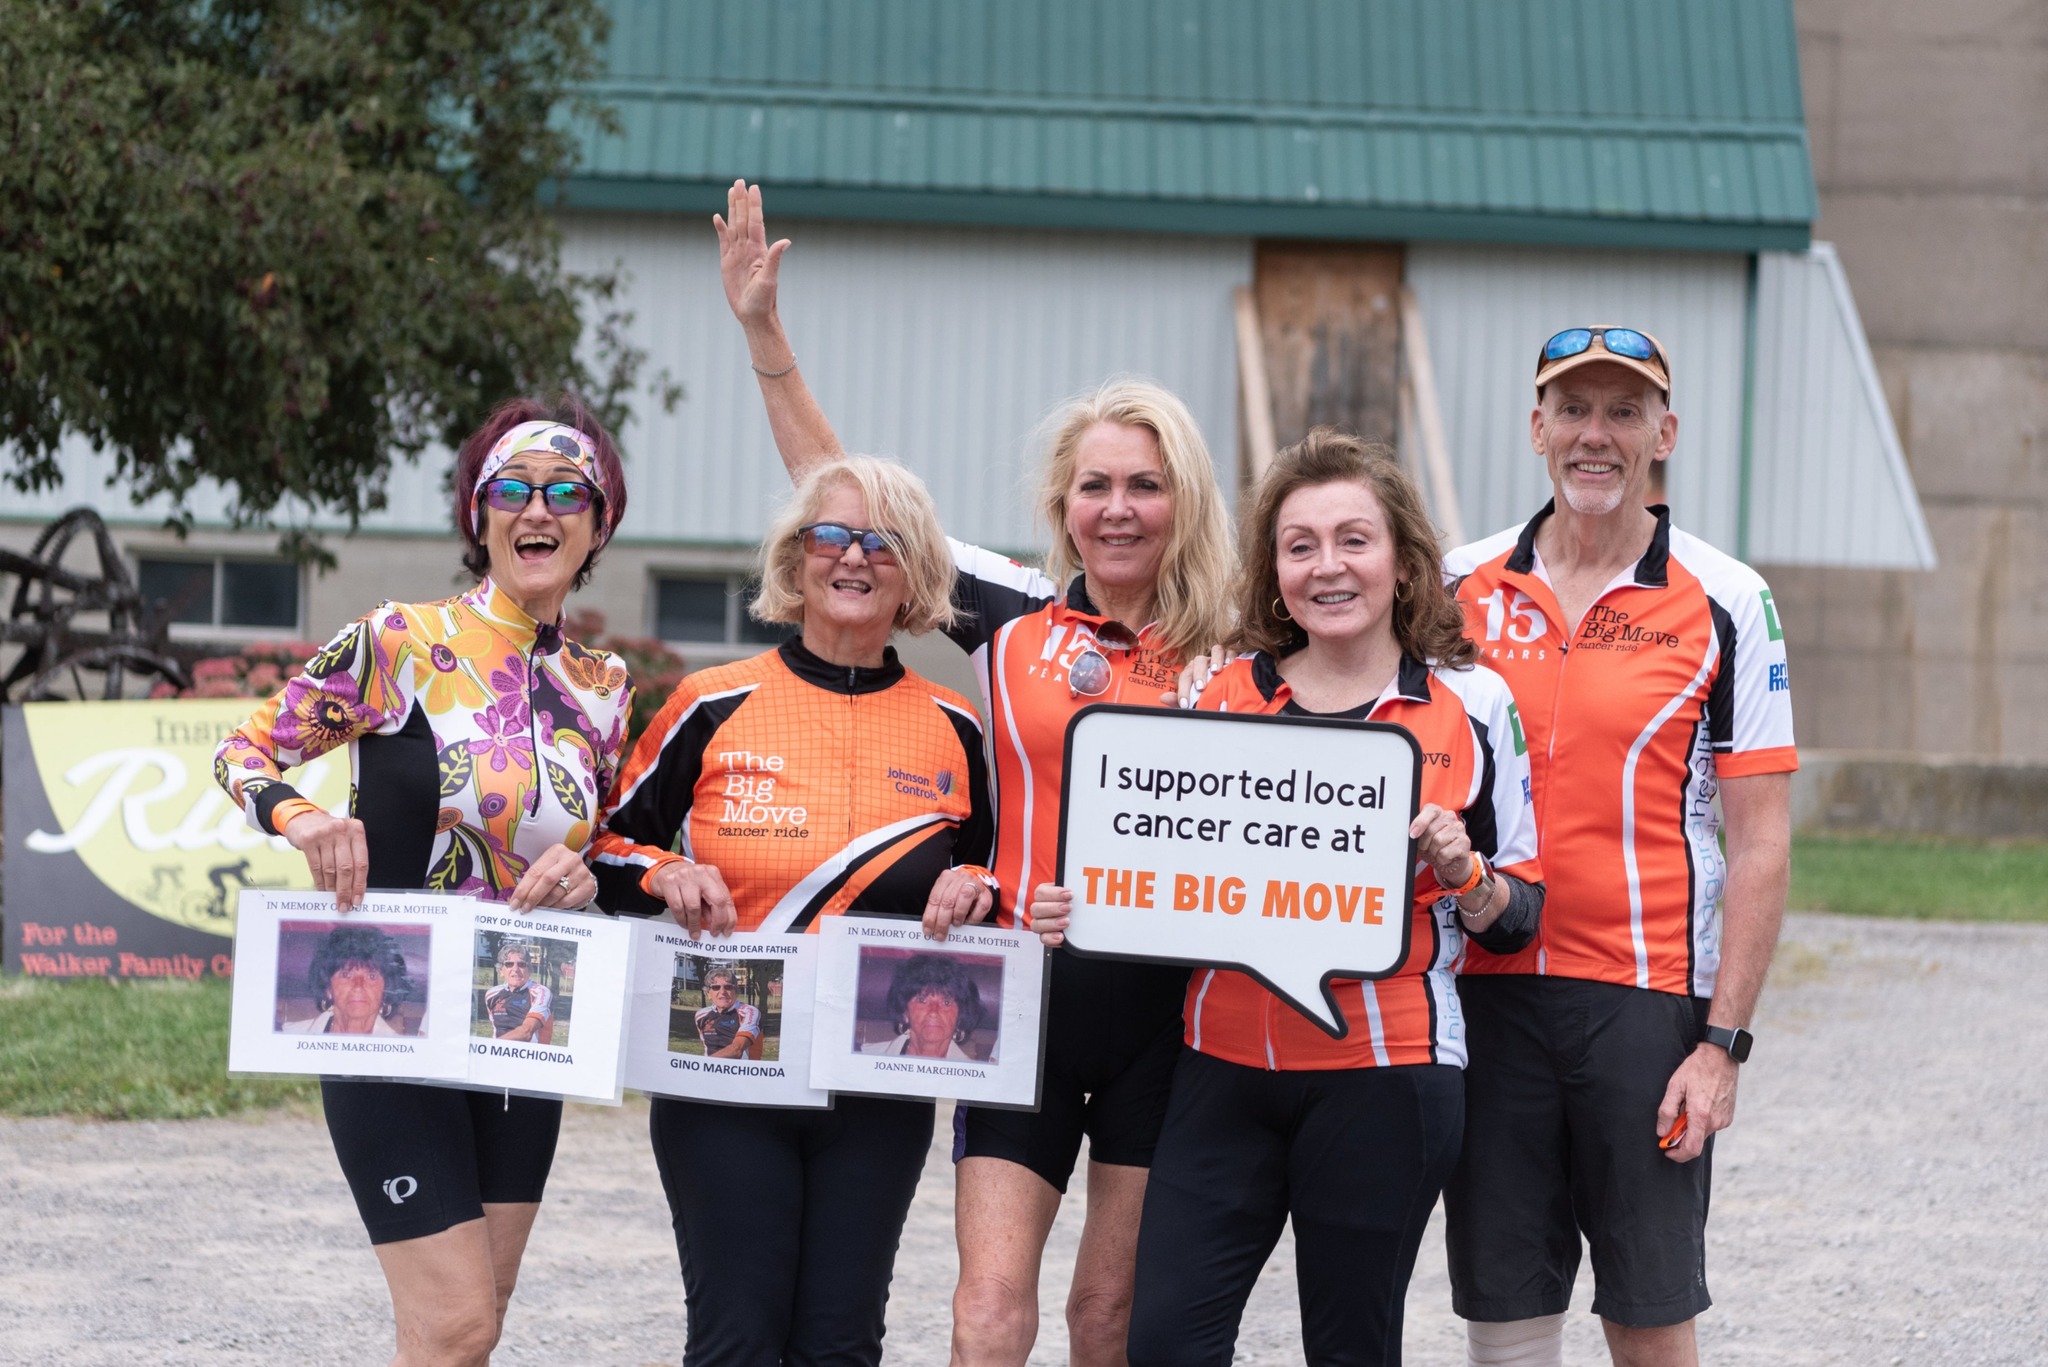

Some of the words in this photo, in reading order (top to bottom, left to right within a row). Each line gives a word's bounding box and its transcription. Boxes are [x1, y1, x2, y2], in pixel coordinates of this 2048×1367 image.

[1478, 588, 1547, 643] 15
[1589, 605, 1629, 624] The
[1580, 621, 1620, 643] Big
[1618, 624, 1680, 649] Move
[1575, 641, 1614, 651] cancer
[1615, 643, 1638, 652] ride
[1028, 665, 1064, 683] YEA
[1130, 661, 1168, 683] Big
[1128, 676, 1166, 690] cancer
[720, 751, 784, 773] The
[1422, 752, 1451, 768] ve
[887, 767, 930, 786] Johnson
[722, 774, 776, 803] Big
[895, 782, 938, 801] Controls
[1118, 766, 1297, 804] supported
[1305, 770, 1386, 810] local
[720, 800, 808, 825] Move
[717, 827, 769, 838] cancer
[774, 826, 809, 839] ride
[1113, 812, 1232, 843] cancer
[1243, 821, 1320, 850] care
[1331, 825, 1365, 854] at
[1083, 867, 1156, 909] THE
[1173, 874, 1247, 916] BIG
[1261, 880, 1385, 926] MOVE
[267, 901, 278, 910] IN
[280, 902, 327, 911] MEMORY
[372, 904, 401, 913] DEAR
[403, 905, 448, 915] MOTHER
[21, 923, 68, 946] For
[73, 922, 117, 945] the
[475, 915, 498, 925] ORY
[514, 919, 533, 930] OUR
[535, 922, 559, 933] DEAR
[560, 926, 593, 937] FATHER
[654, 934, 664, 943] IN
[665, 937, 704, 950] MEMORY
[705, 943, 717, 952] OF
[718, 945, 738, 953] OUR
[740, 945, 764, 953] DEAR
[765, 945, 798, 954] FATHER
[847, 927, 859, 935] IN
[861, 928, 906, 938] MEMORY
[908, 932, 921, 940] OF
[948, 933, 976, 944] DEAR
[977, 937, 1020, 948] MOTHER
[21, 954, 112, 977] Walker
[117, 952, 205, 980] Family
[296, 1041, 338, 1051] JOANNE
[341, 1043, 415, 1053] MARCHIONDA
[468, 1043, 487, 1055] NO
[490, 1045, 574, 1065] MARCHIONDA
[670, 1058, 700, 1071] GINO
[703, 1062, 786, 1078] MARCHIONDA
[874, 1061, 914, 1073] JOANNE
[916, 1065, 986, 1079] MARCHIONDA
